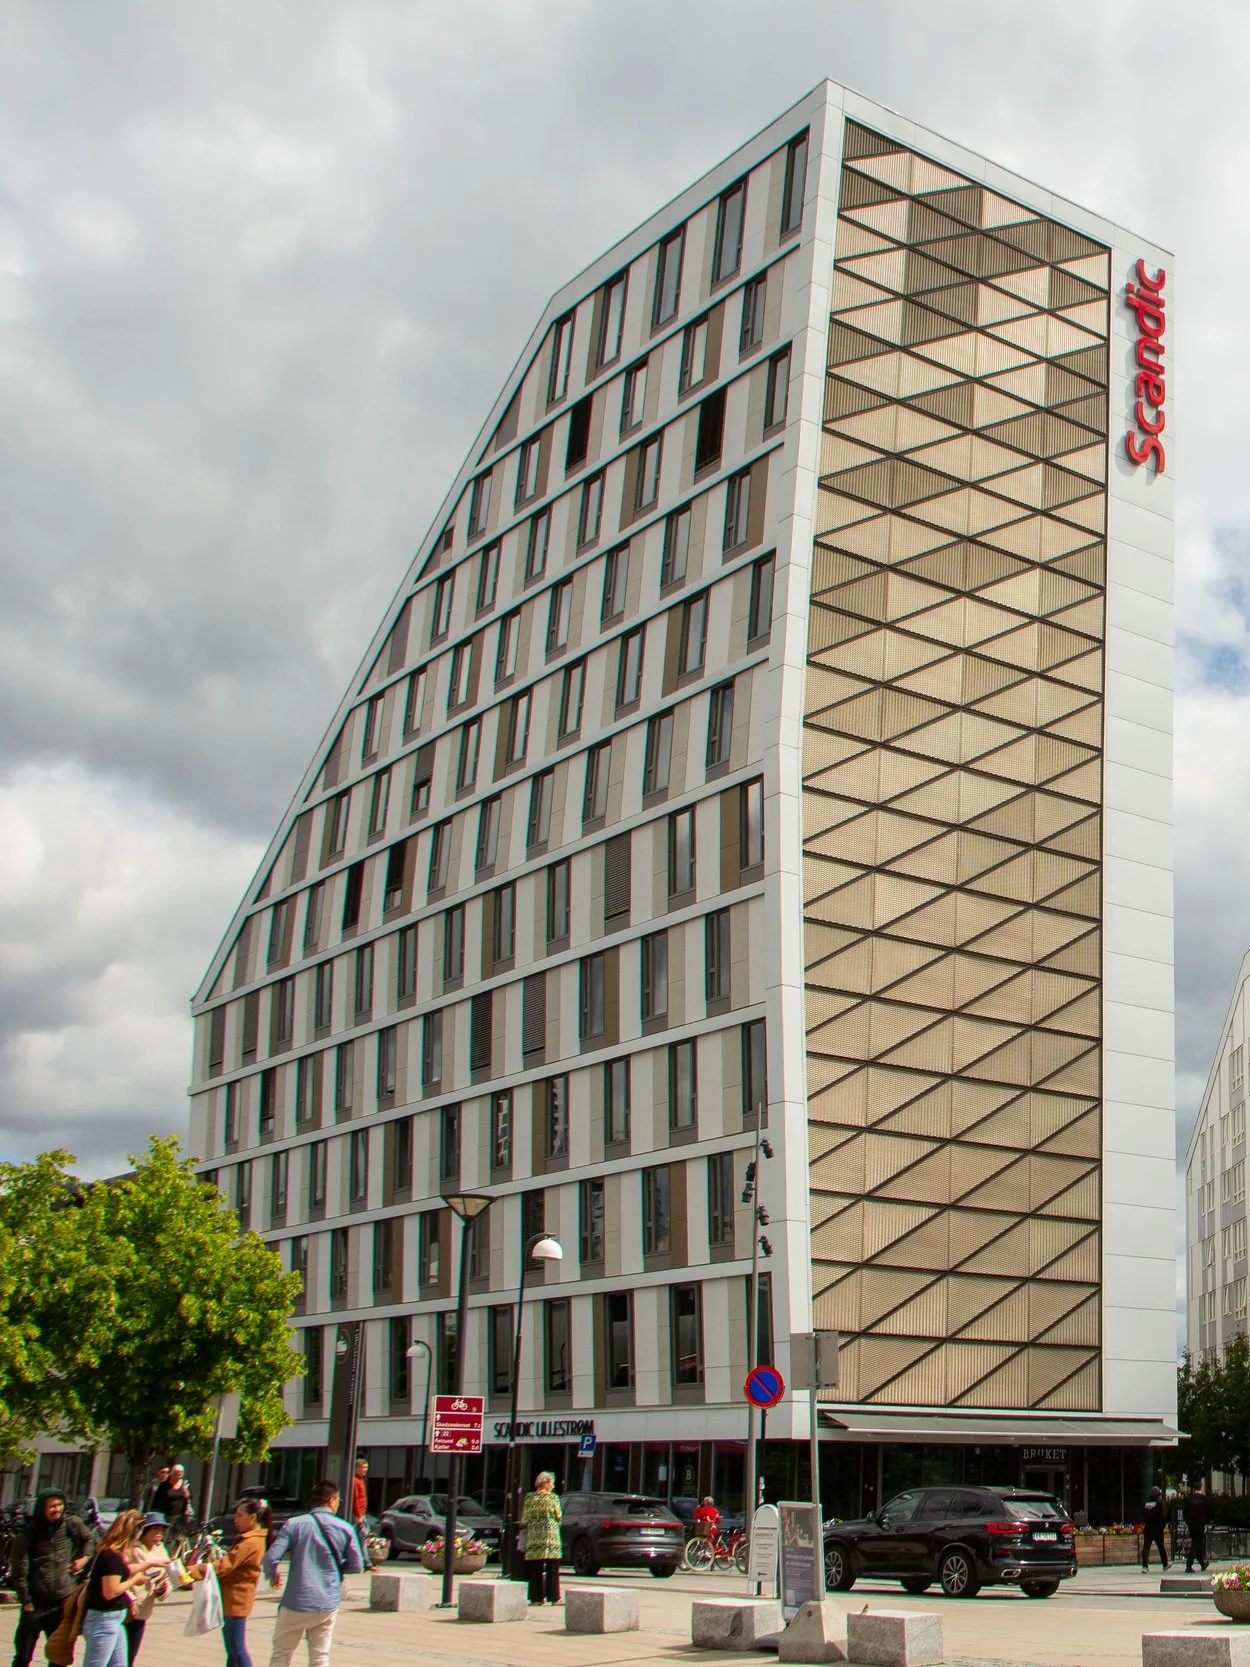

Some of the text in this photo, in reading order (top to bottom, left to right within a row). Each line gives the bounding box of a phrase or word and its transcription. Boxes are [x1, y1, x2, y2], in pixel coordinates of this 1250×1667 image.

[1125, 258, 1166, 473] Scandic
[536, 1420, 594, 1437] LILLESTRØM
[582, 1437, 592, 1450] P
